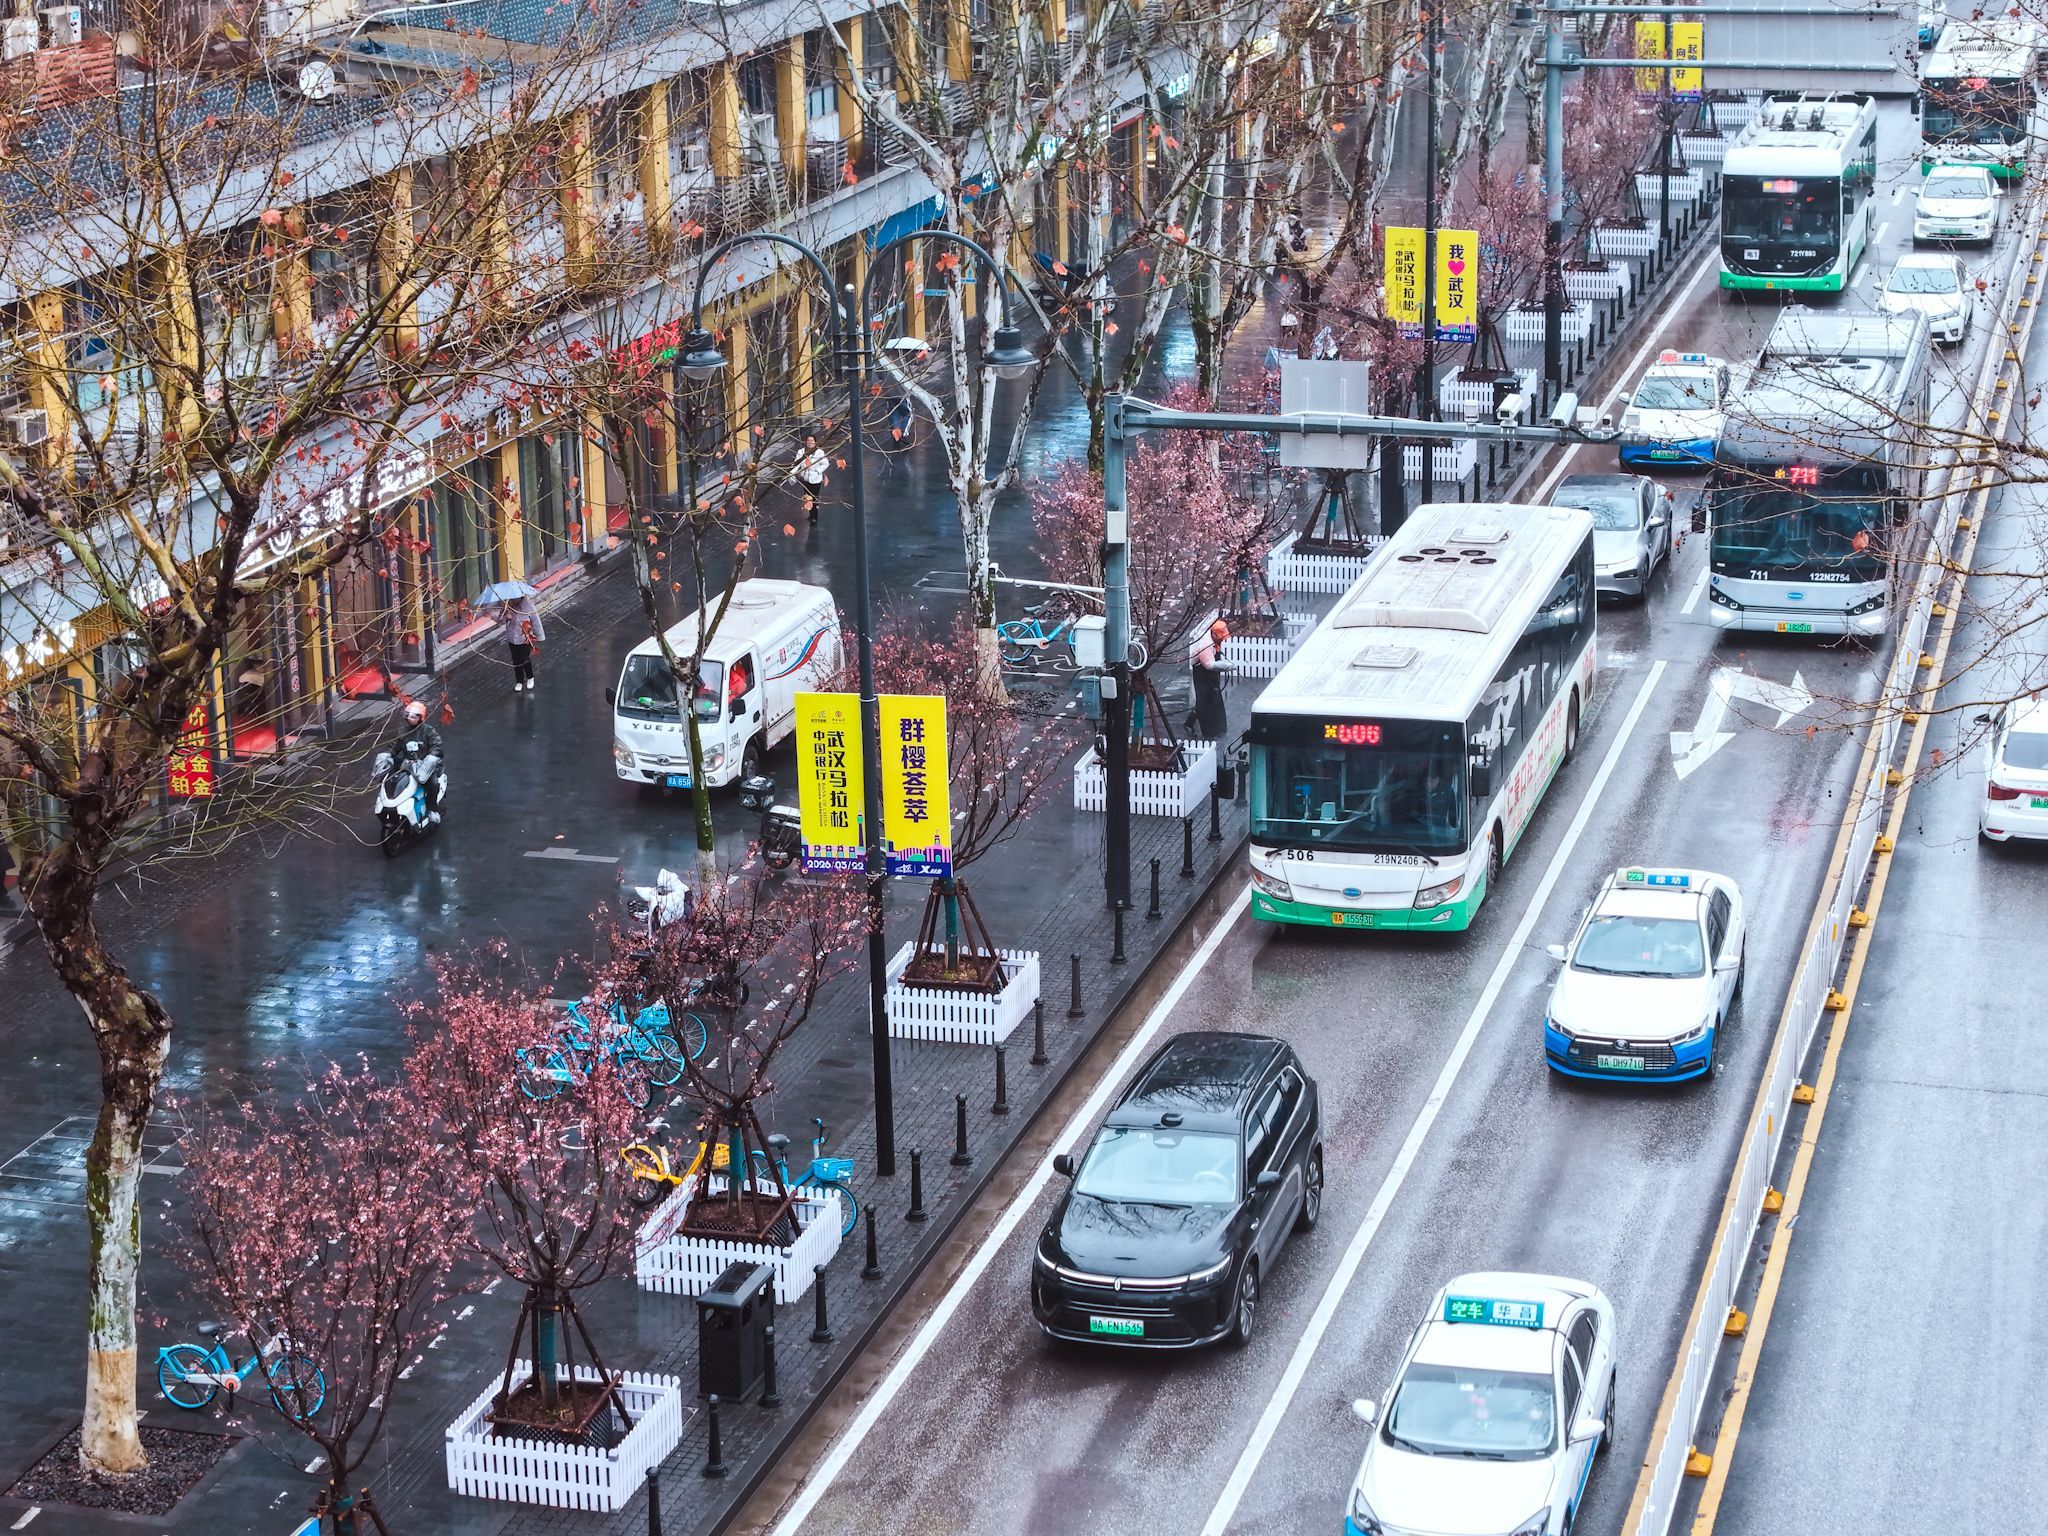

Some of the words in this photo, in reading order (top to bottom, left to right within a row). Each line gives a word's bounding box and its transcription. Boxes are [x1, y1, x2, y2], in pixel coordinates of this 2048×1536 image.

[1675, 48, 1685, 79] 向好
[1449, 244, 1464, 260] 我
[1403, 250, 1415, 311] 武汉马拉松
[1448, 277, 1464, 309] 武汉
[1790, 467, 1818, 485] 711
[1750, 569, 1768, 580] 711
[1809, 572, 1851, 583] 122N2754
[170, 754, 209, 773] 黄金
[813, 730, 827, 781] 中国银行
[827, 730, 849, 828] 武汉马拉松
[900, 718, 929, 823] 群樱荟萃
[171, 776, 211, 796] 铂金
[1287, 850, 1314, 861] 506
[1374, 855, 1419, 866] 219N2406
[807, 859, 865, 871] 2026/03/22
[1613, 1058, 1643, 1069] DH9710
[1451, 1301, 1483, 1319] 空车
[1498, 1304, 1532, 1319] 华昌
[1107, 1320, 1143, 1334] FN1535
